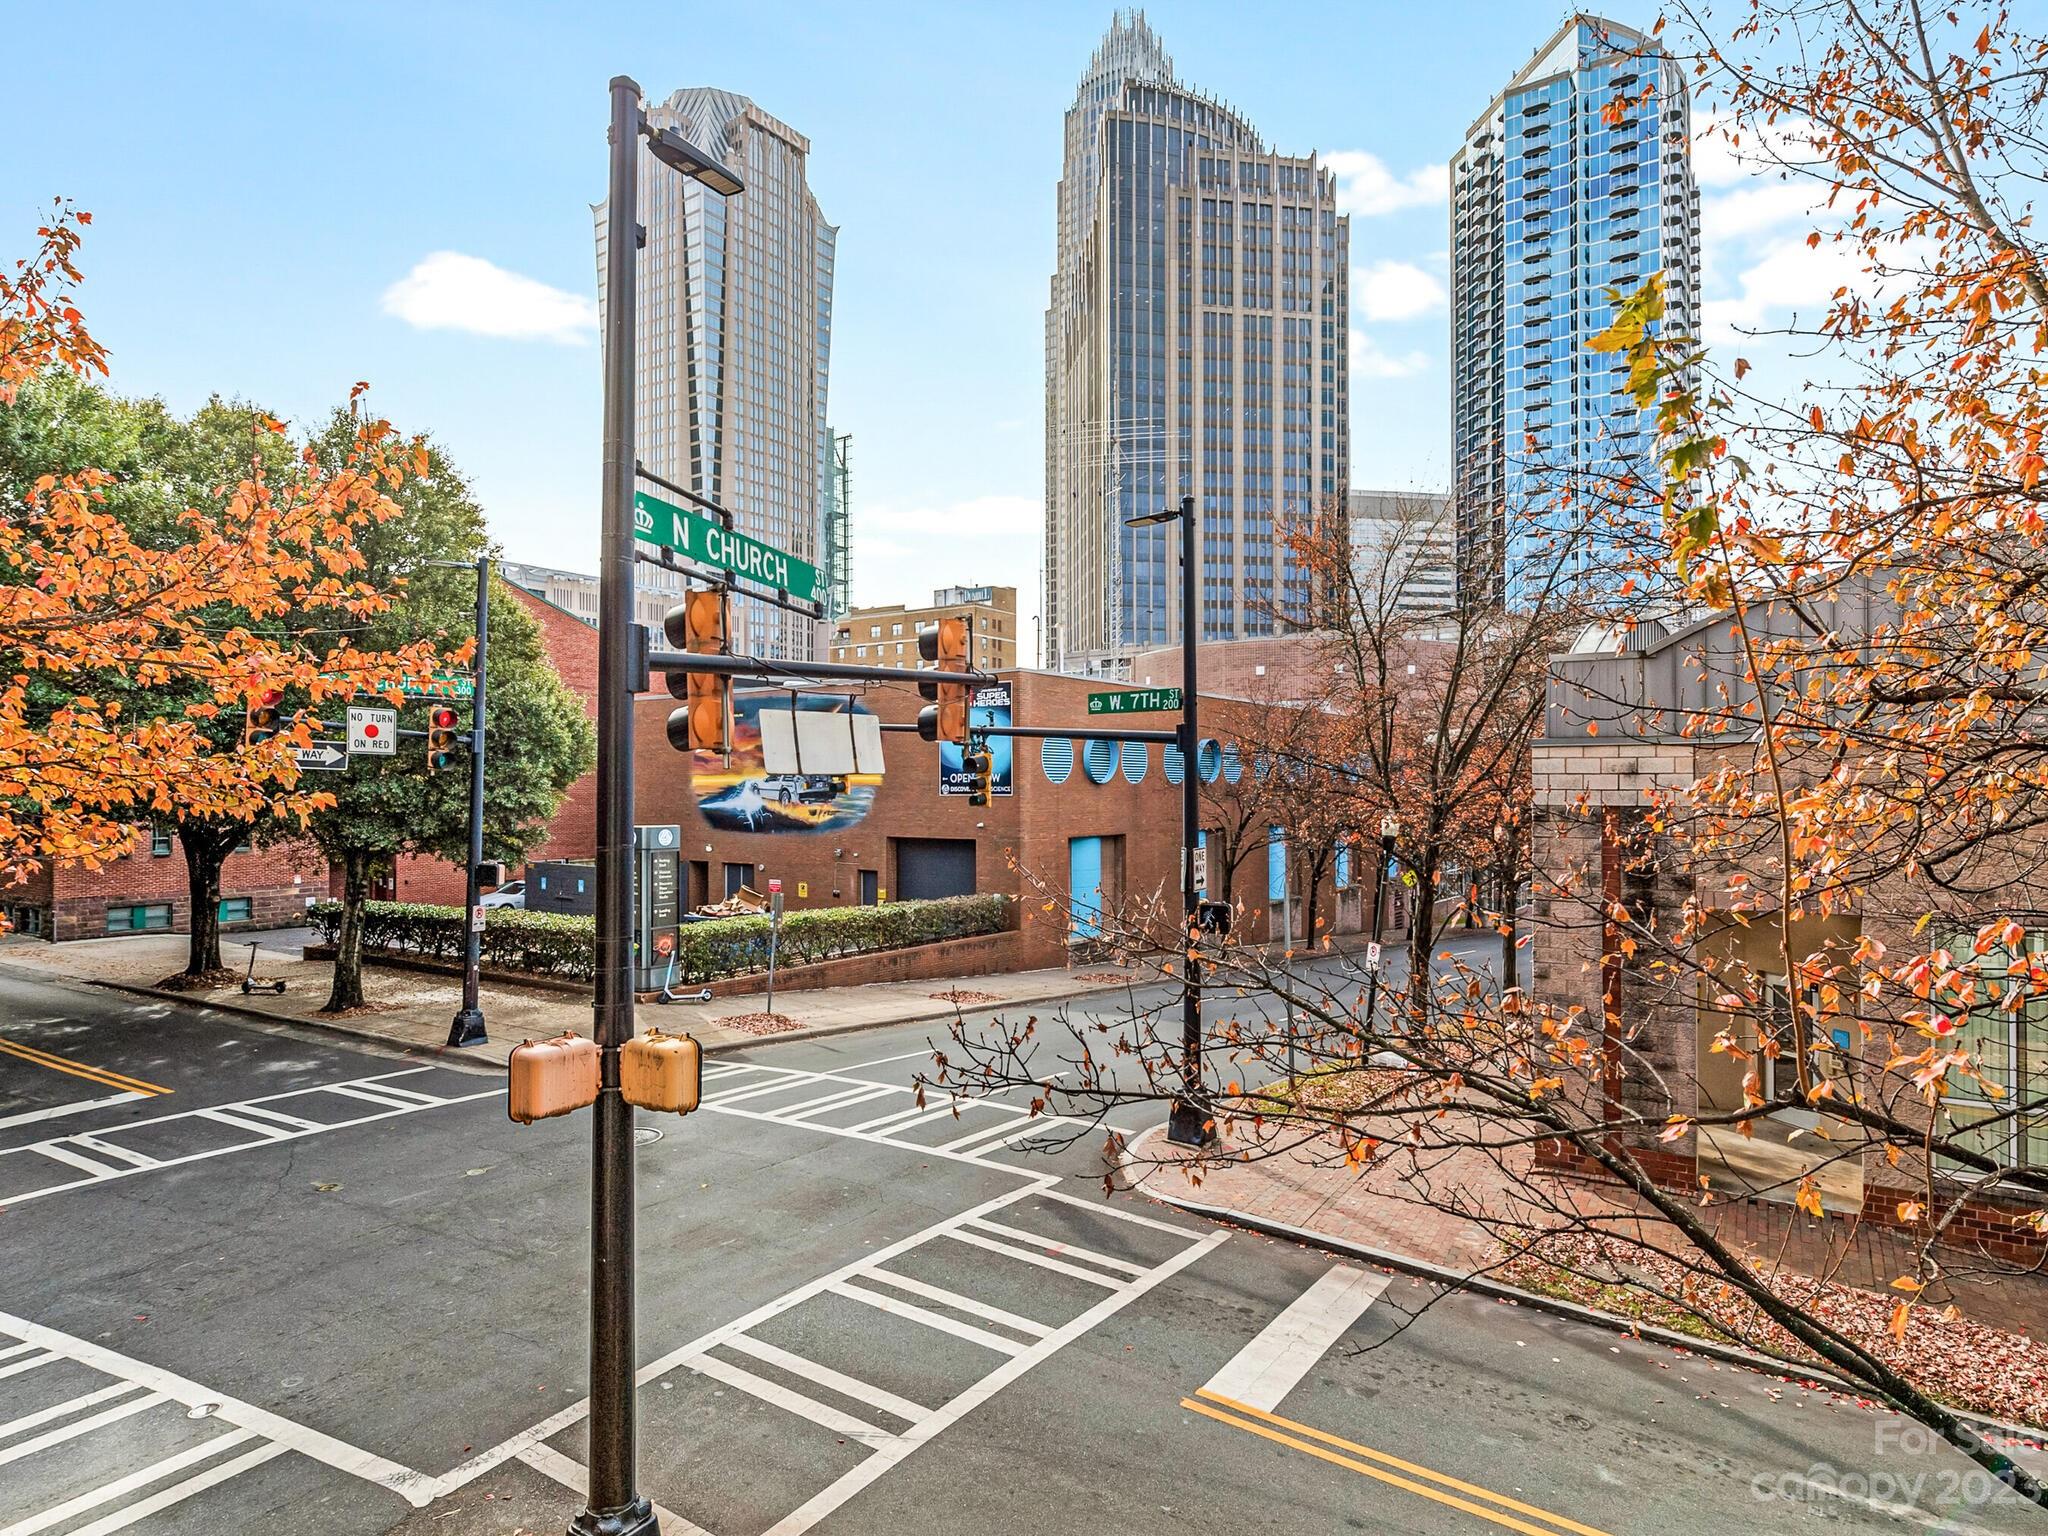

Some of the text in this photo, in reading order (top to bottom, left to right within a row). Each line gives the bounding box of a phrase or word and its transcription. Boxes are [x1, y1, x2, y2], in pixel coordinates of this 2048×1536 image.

[1135, 76, 1161, 90] FIFTH
[1164, 83, 1191, 98] THIRD
[672, 513, 826, 587] N CHURCH ST
[810, 585, 827, 606] 400
[456, 686, 472, 695] 300
[976, 691, 1007, 700] SUPER
[972, 698, 1011, 707] HEROES
[1109, 688, 1179, 710] W. 7TH ST
[1162, 698, 1179, 710] 200
[351, 712, 393, 723] NO TURN
[353, 739, 390, 749] ON RED
[302, 750, 323, 760] WAY
[949, 773, 976, 783] OPEN
[1194, 851, 1205, 862] ONE
[1195, 863, 1206, 874] WAY
